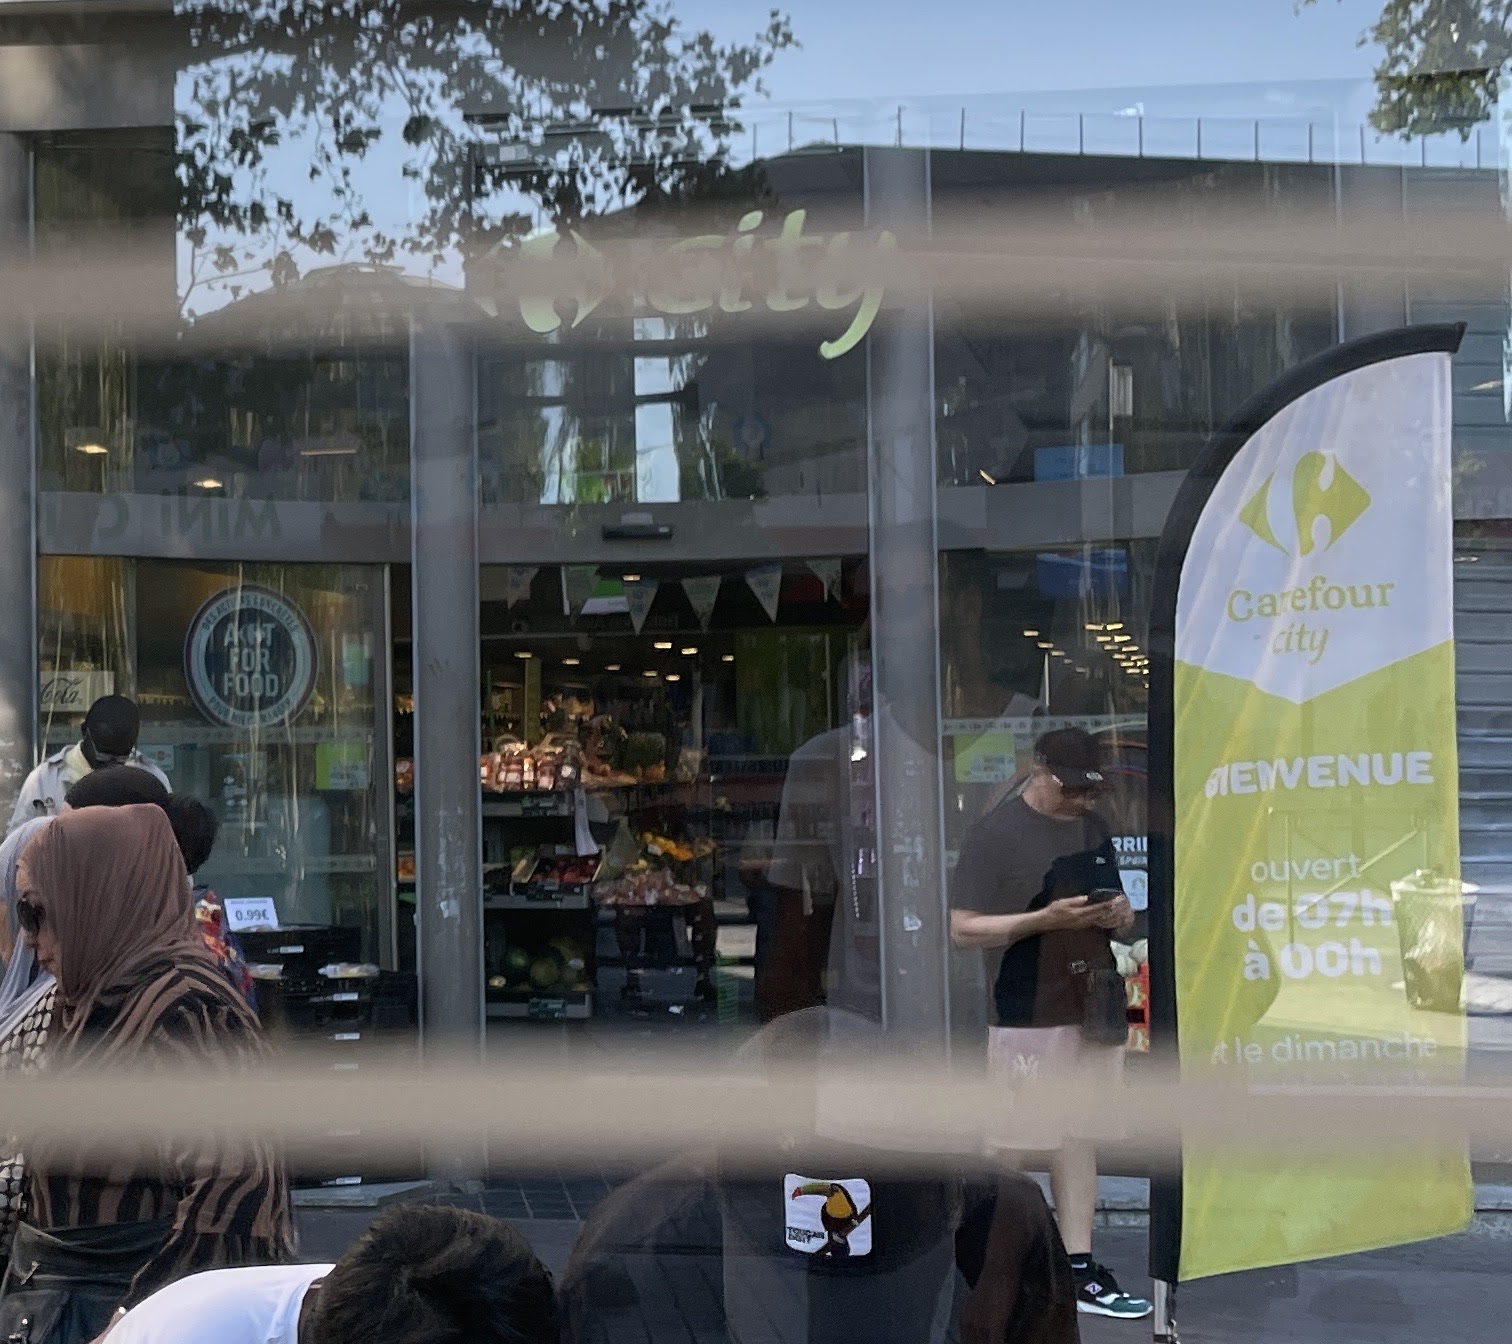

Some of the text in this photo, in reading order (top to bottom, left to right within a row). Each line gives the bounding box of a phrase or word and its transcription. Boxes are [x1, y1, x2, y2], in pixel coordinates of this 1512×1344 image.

[1272, 622, 1330, 665] city
[228, 647, 272, 673] FOR
[223, 672, 280, 698] FOOD
[1250, 853, 1362, 883] ouvert
[1231, 887, 1393, 932] de 07h
[1243, 936, 1382, 981] à 00h
[1234, 1035, 1263, 1064] le
